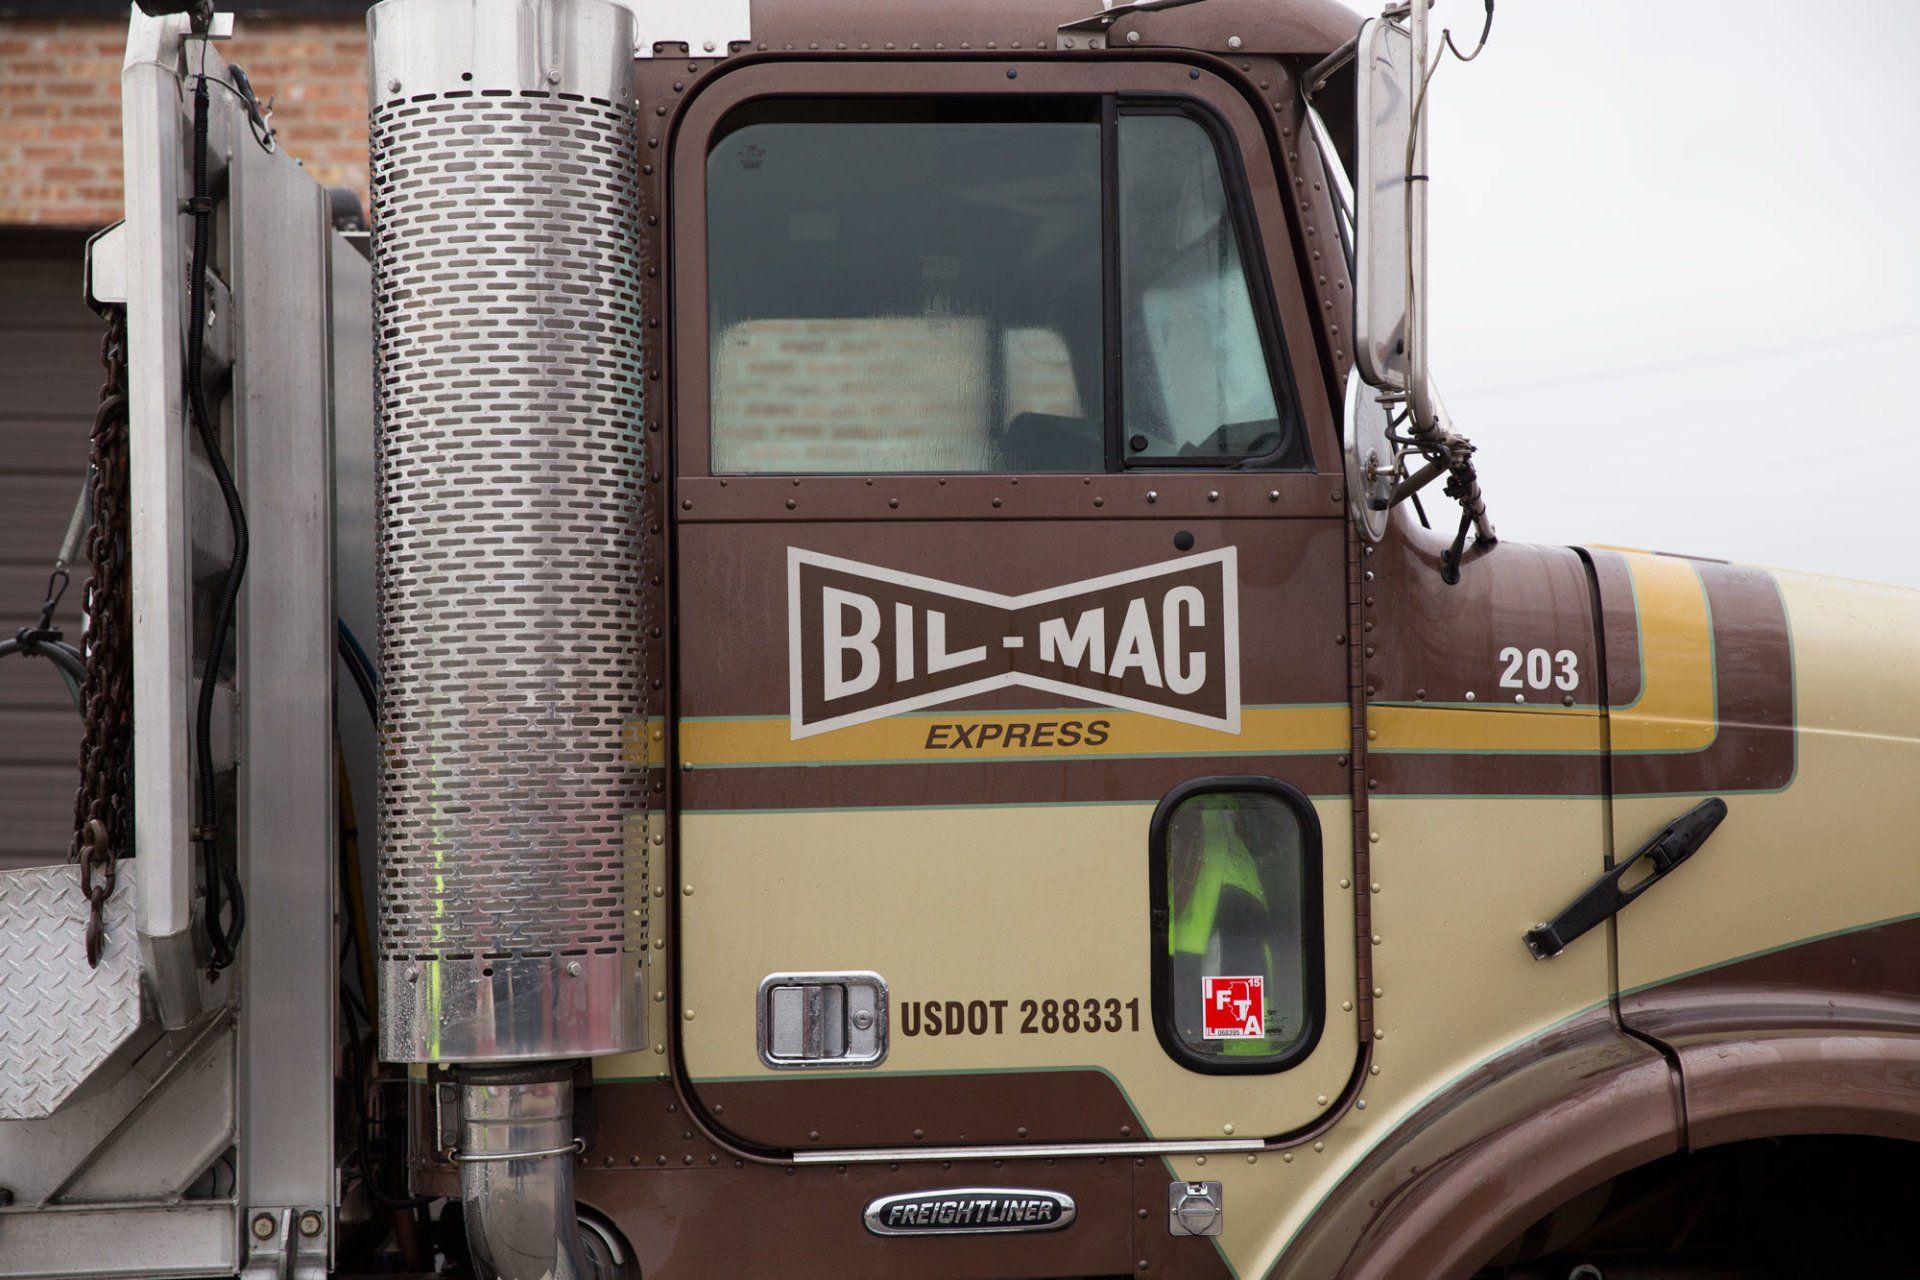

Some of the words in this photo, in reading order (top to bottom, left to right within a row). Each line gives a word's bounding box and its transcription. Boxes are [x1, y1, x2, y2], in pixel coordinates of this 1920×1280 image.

[822, 585, 1206, 701] BIL-MAC
[1499, 646, 1579, 691] 203
[924, 720, 1111, 749] EXPRESS
[1248, 978, 1261, 988] 15
[901, 1000, 1008, 1037] USDOT
[1019, 997, 1140, 1034] 288331
[888, 1200, 1054, 1226] FREIGHTLINER
